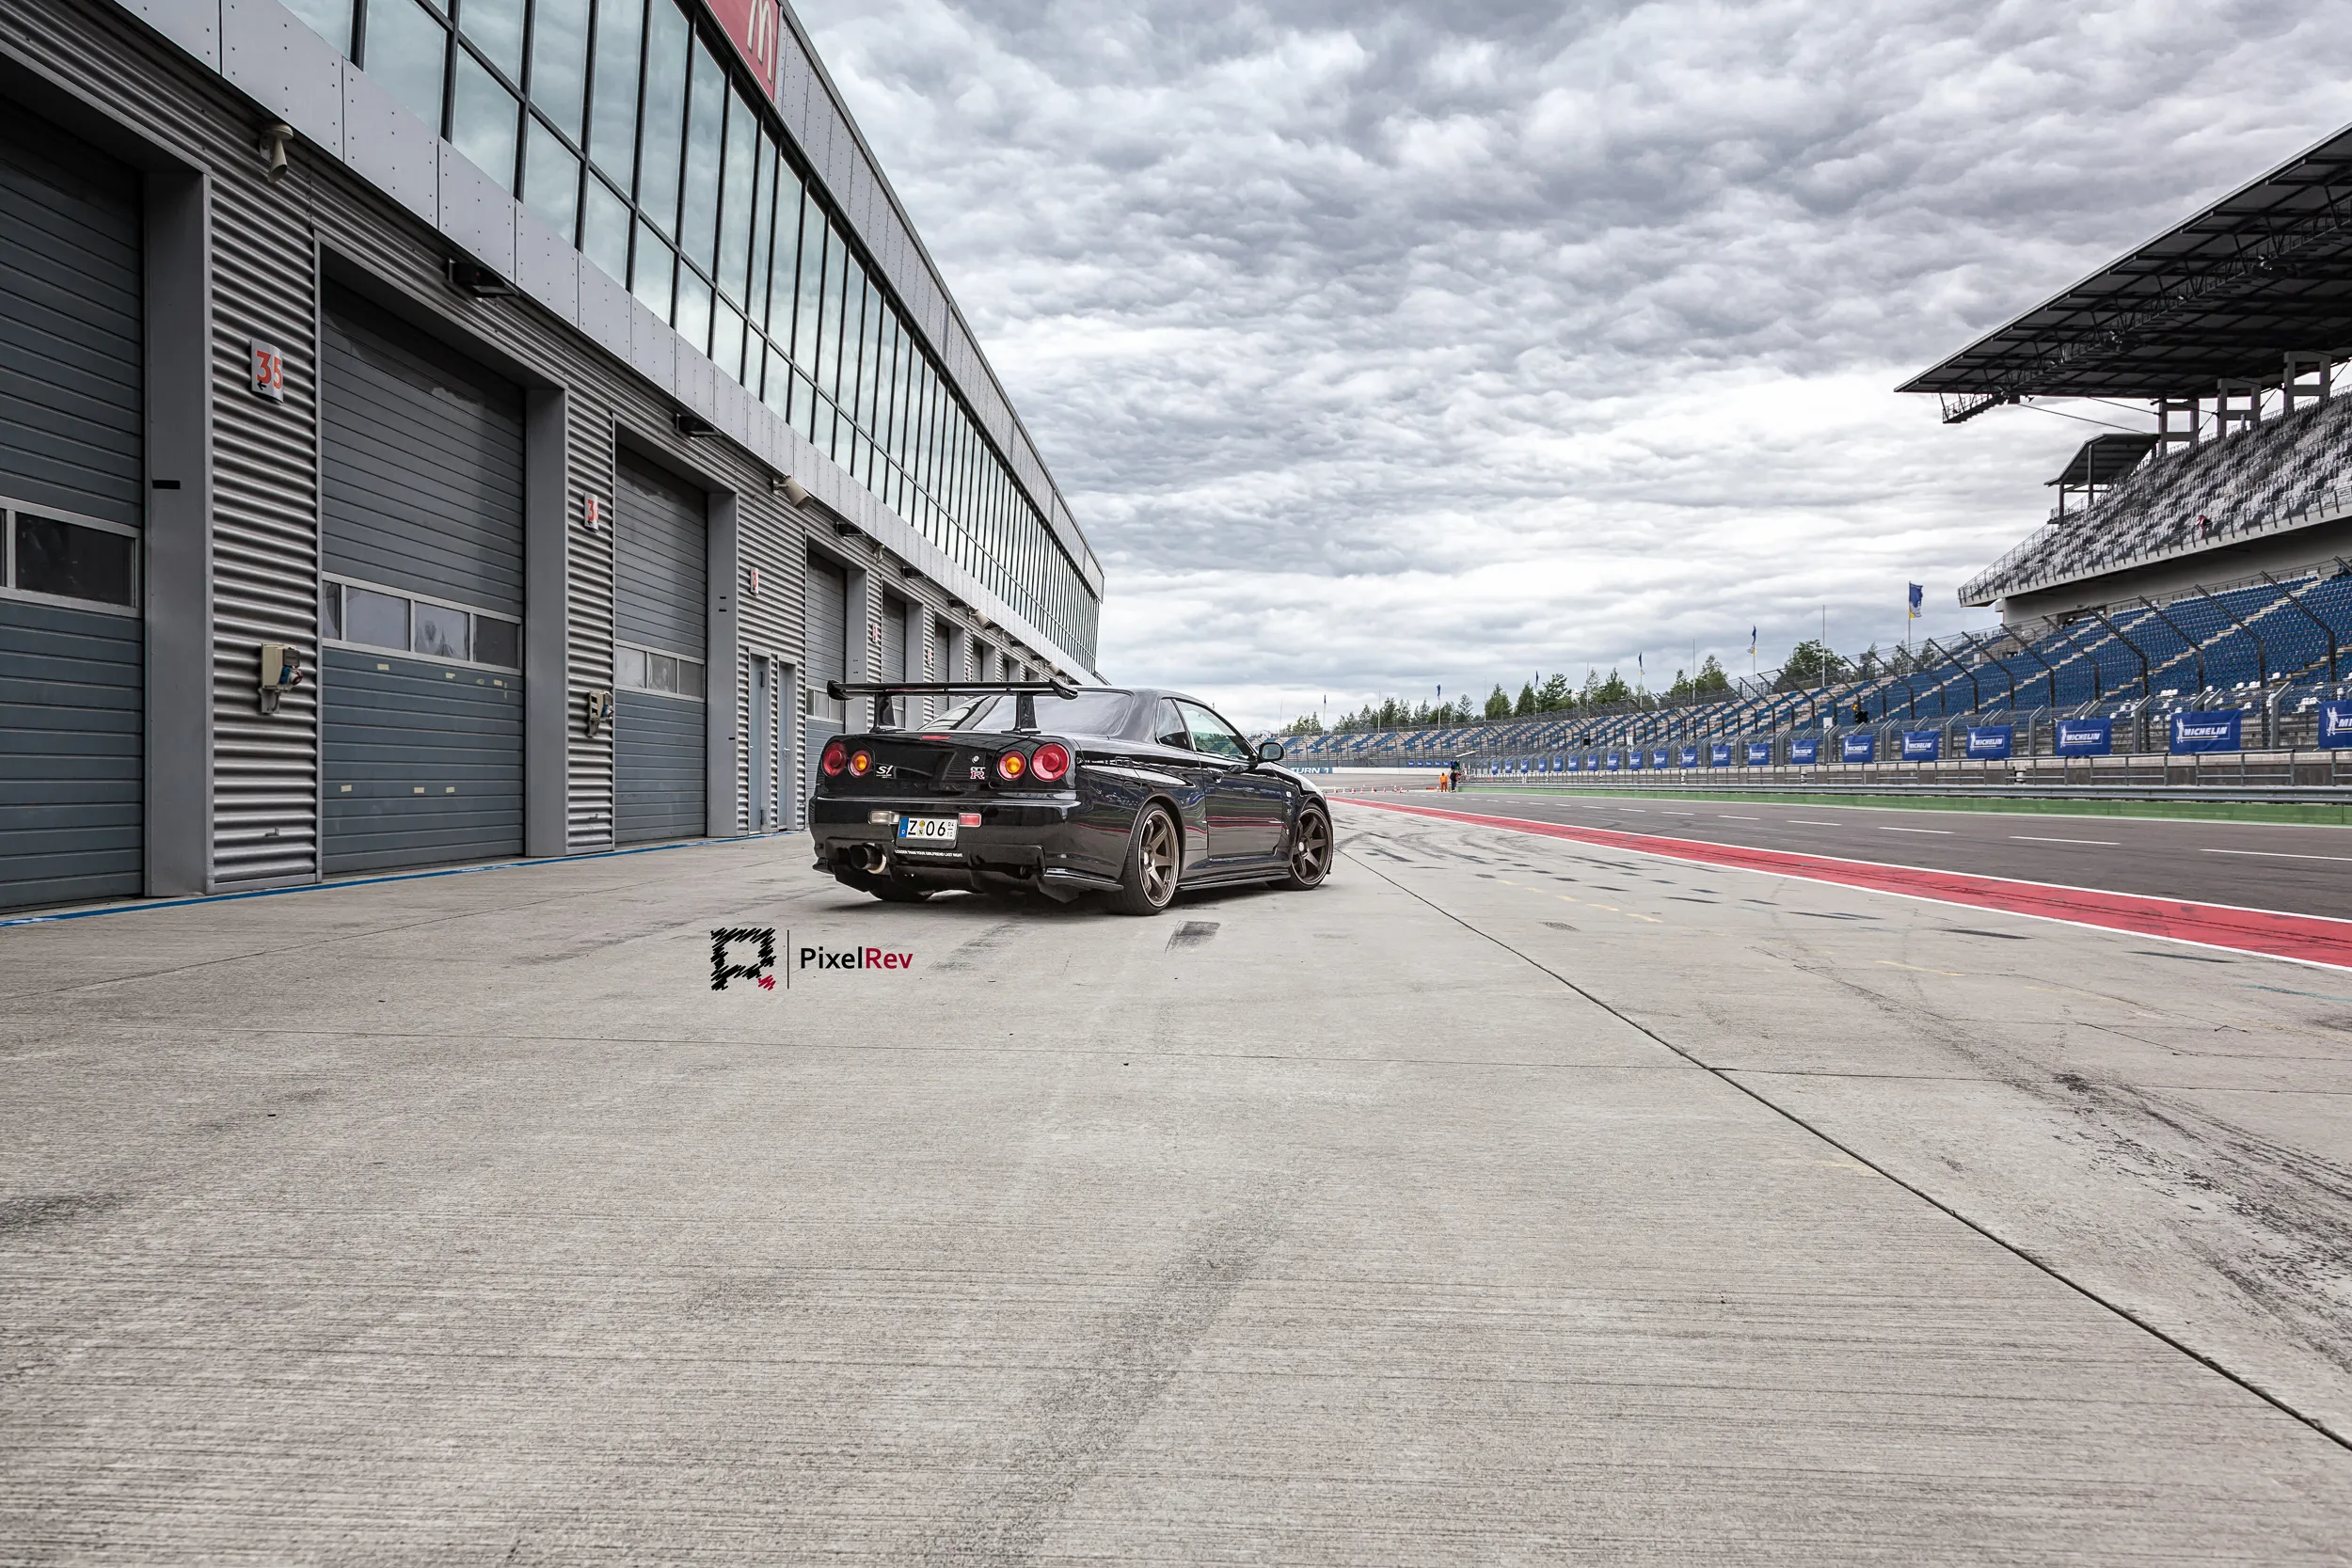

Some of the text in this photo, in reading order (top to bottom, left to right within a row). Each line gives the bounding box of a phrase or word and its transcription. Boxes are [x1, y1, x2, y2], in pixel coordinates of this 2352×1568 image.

[255, 349, 282, 389] 35
[2184, 726, 2228, 736] MICHELIN
[1975, 737, 2003, 746] MICHELIN
[2066, 733, 2101, 741] MICHELIN
